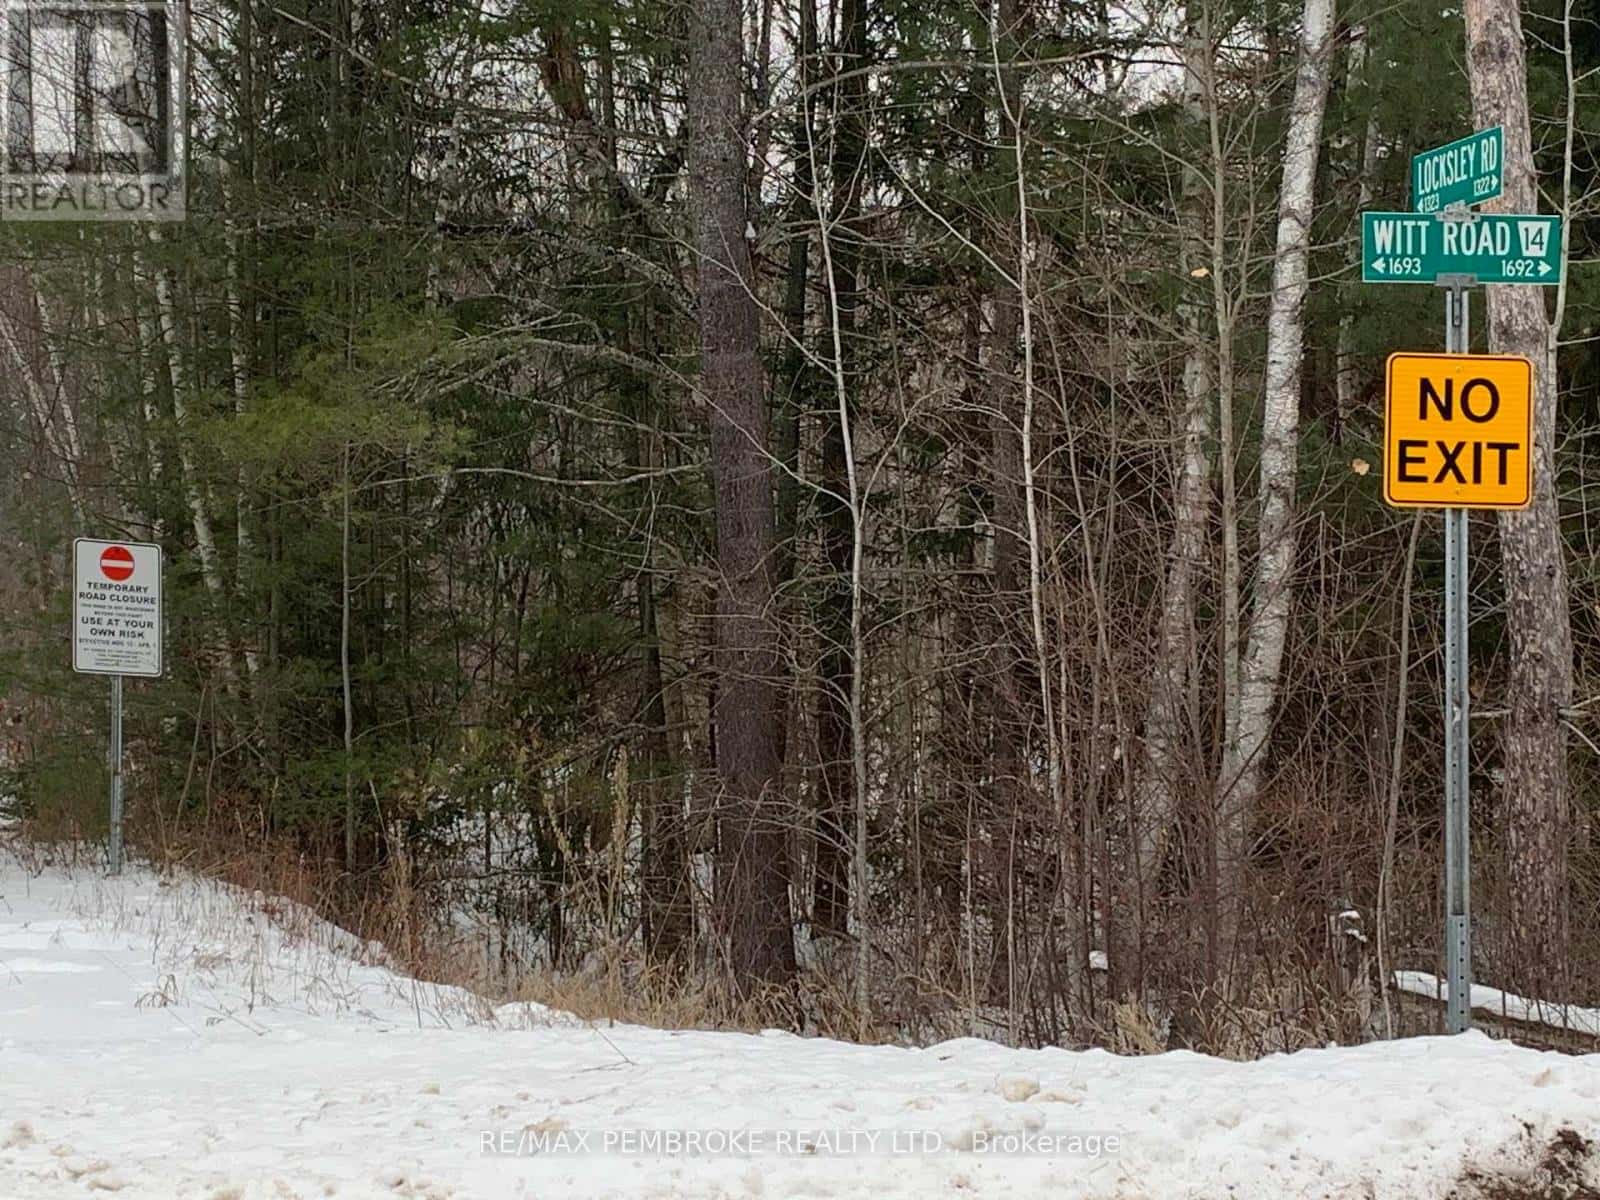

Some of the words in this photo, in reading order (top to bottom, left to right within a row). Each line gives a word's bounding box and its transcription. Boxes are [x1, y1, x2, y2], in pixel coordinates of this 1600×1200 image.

[1418, 142, 1477, 195] LOCKSLEY
[1480, 136, 1498, 174] RD
[1423, 193, 1440, 212] 1323
[1473, 175, 1490, 197] 1322
[1373, 220, 1430, 255] WITT
[1443, 221, 1511, 256] ROAD
[1523, 227, 1545, 251] 14
[1388, 257, 1422, 275] 1693
[1502, 259, 1535, 277] 1692
[1419, 377, 1500, 423] NO
[1397, 439, 1520, 485] EXIT
[79, 591, 107, 601] ROAD
[109, 593, 157, 605] CLOSURE
[87, 582, 149, 593] TEMPORARY
[81, 616, 103, 626] USE
[106, 618, 120, 626] AT
[125, 619, 154, 629] YOUR
[90, 627, 115, 637] OWN
[119, 629, 144, 639] RISK
